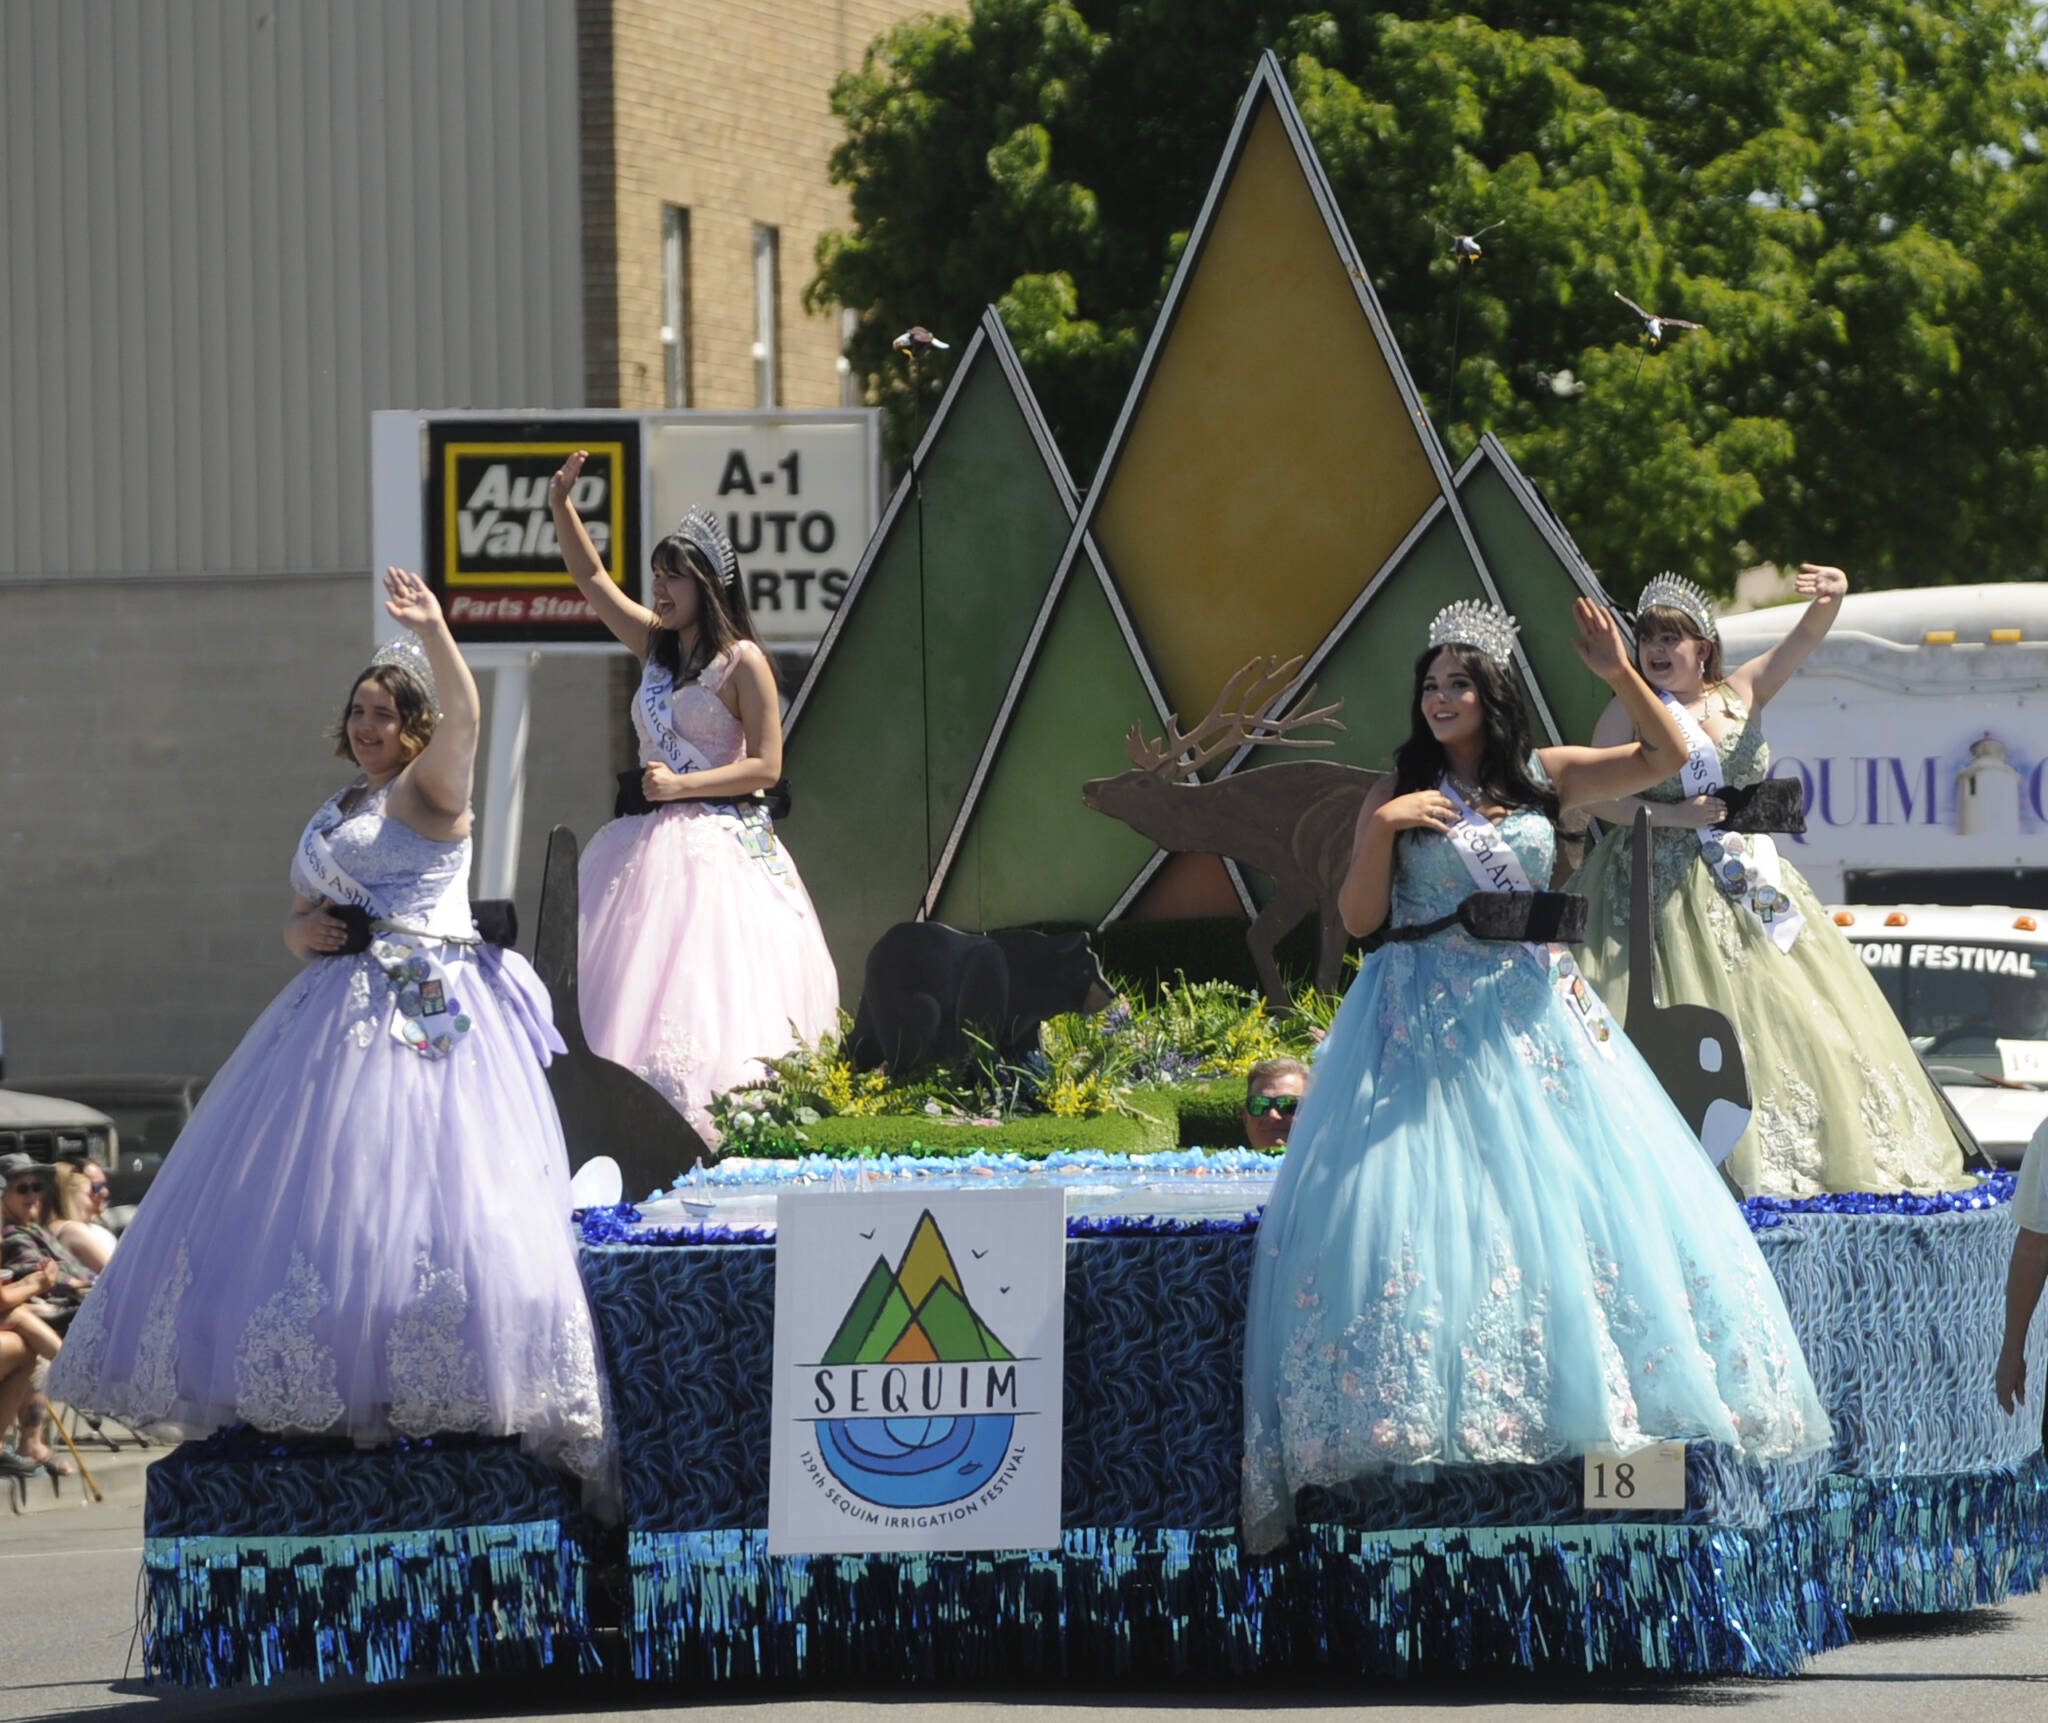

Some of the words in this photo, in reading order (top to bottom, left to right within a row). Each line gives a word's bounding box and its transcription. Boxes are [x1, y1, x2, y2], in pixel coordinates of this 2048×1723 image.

[466, 464, 606, 512] Auo
[717, 449, 800, 496] A-1
[728, 510, 836, 554] UTO
[451, 596, 524, 618] Parts
[749, 568, 850, 612] RTS
[1767, 756, 1943, 845] QUIM
[1852, 943, 1903, 968] ION
[1909, 944, 2038, 979] FESTIVAL
[814, 1365, 1017, 1414] SEQUIM
[800, 1450, 827, 1488] 129th
[825, 1488, 880, 1525] SEQUIM
[885, 1502, 979, 1529] IRRIGATION
[979, 1445, 1027, 1506] FESTIVAL
[1593, 1463, 1635, 1498] 18
